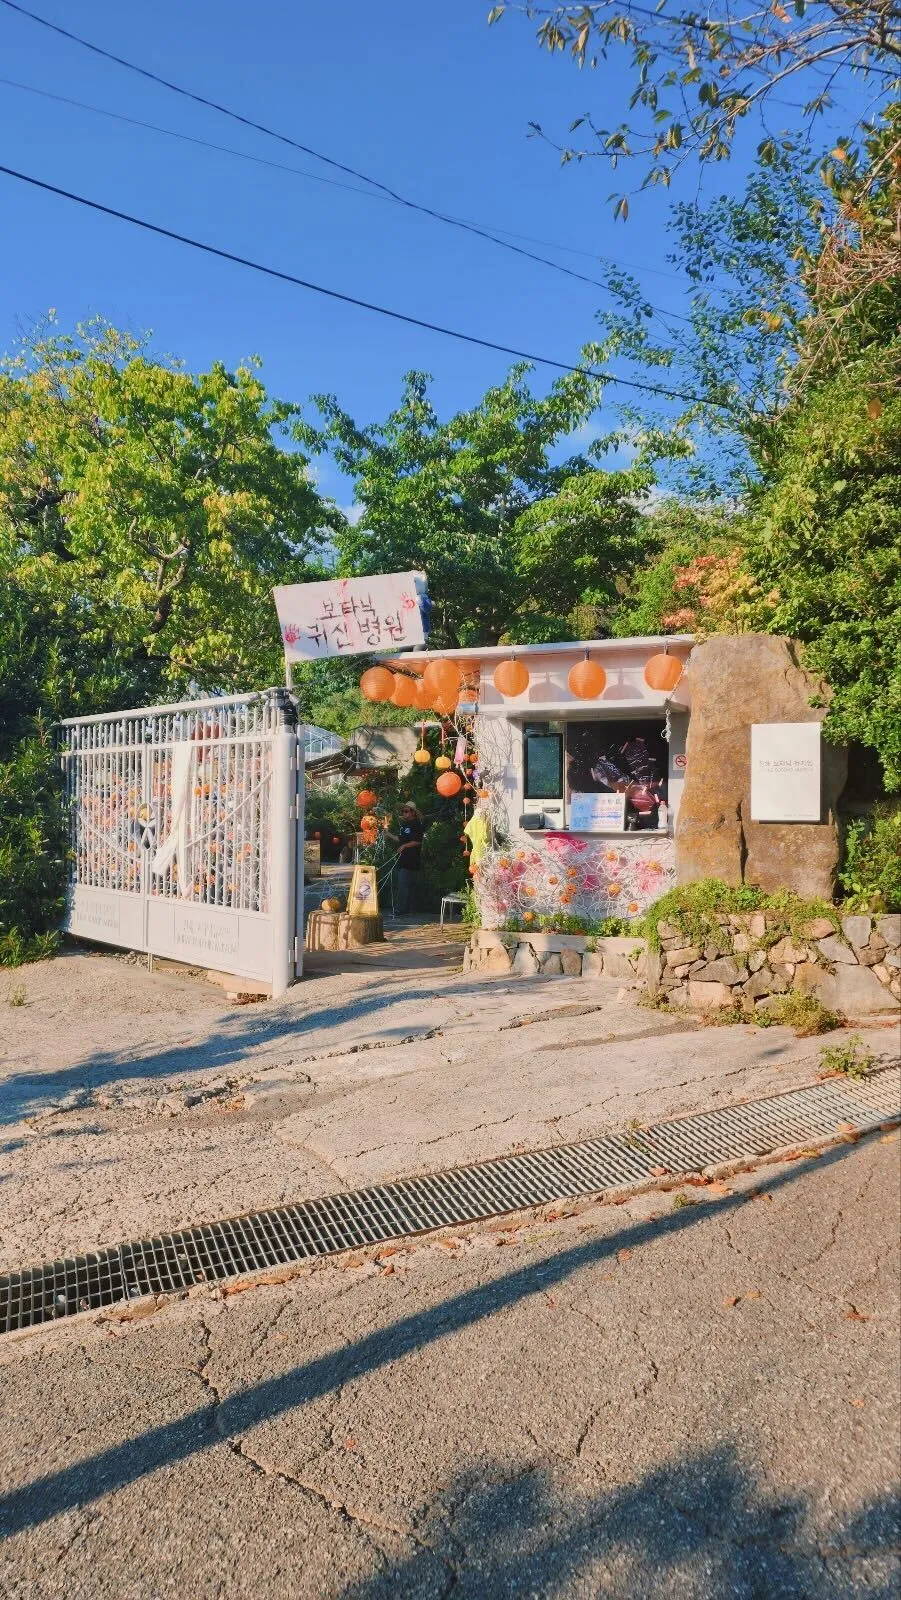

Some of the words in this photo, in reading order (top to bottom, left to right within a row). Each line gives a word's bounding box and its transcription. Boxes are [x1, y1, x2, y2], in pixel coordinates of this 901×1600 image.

[316, 592, 376, 620] 보타닉
[307, 622, 353, 651] 귀신
[357, 610, 407, 646] 병원
